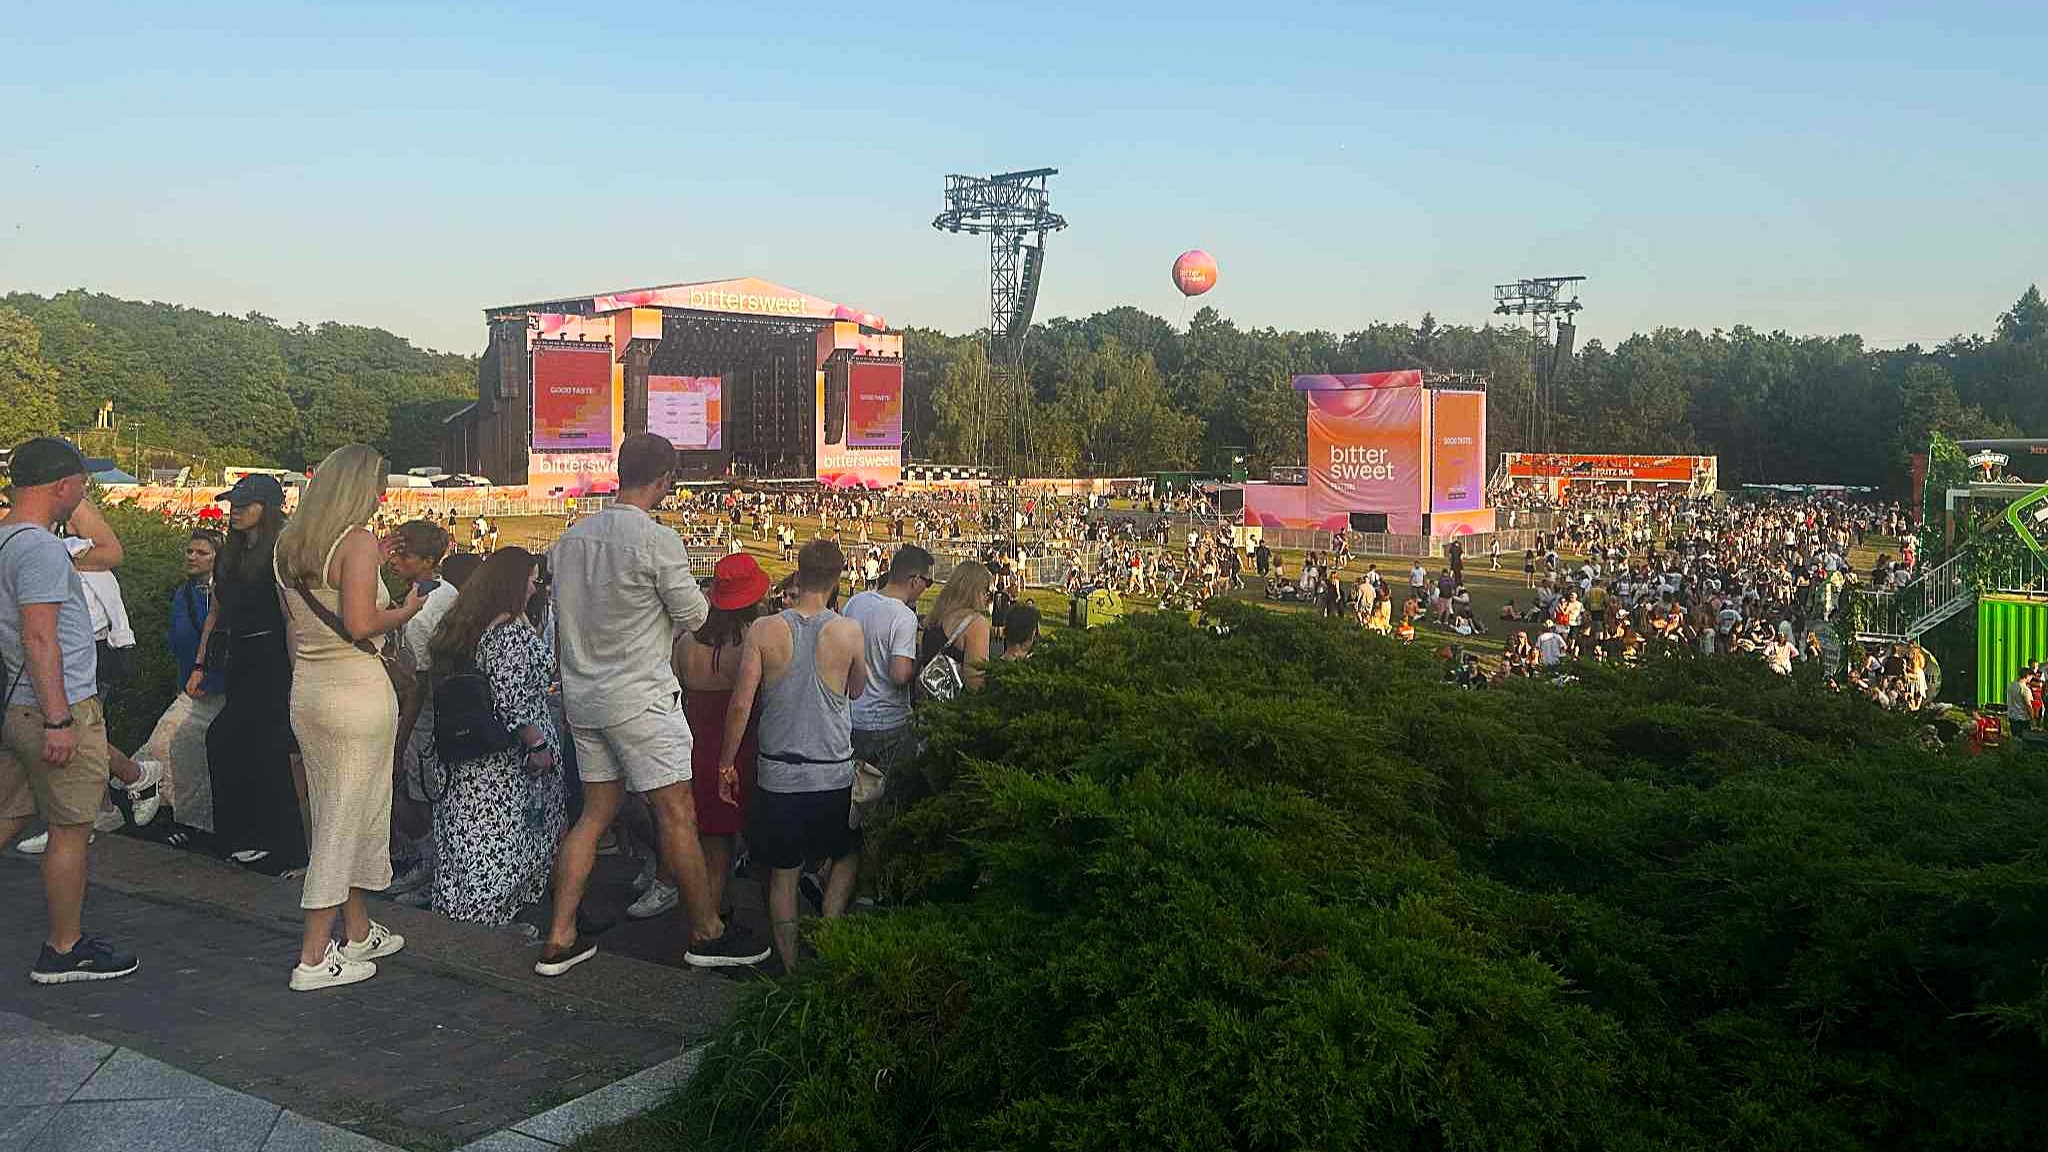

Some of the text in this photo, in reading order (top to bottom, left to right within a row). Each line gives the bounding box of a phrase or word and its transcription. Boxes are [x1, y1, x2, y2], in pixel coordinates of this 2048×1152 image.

[689, 286, 808, 315] bittersweet
[550, 386, 571, 394] GOOD
[823, 453, 896, 468] bittersweet
[1330, 445, 1389, 464] bitter
[541, 458, 618, 473] bitterswe
[1330, 461, 1395, 481] sweet
[1618, 468, 1635, 477] BAR
